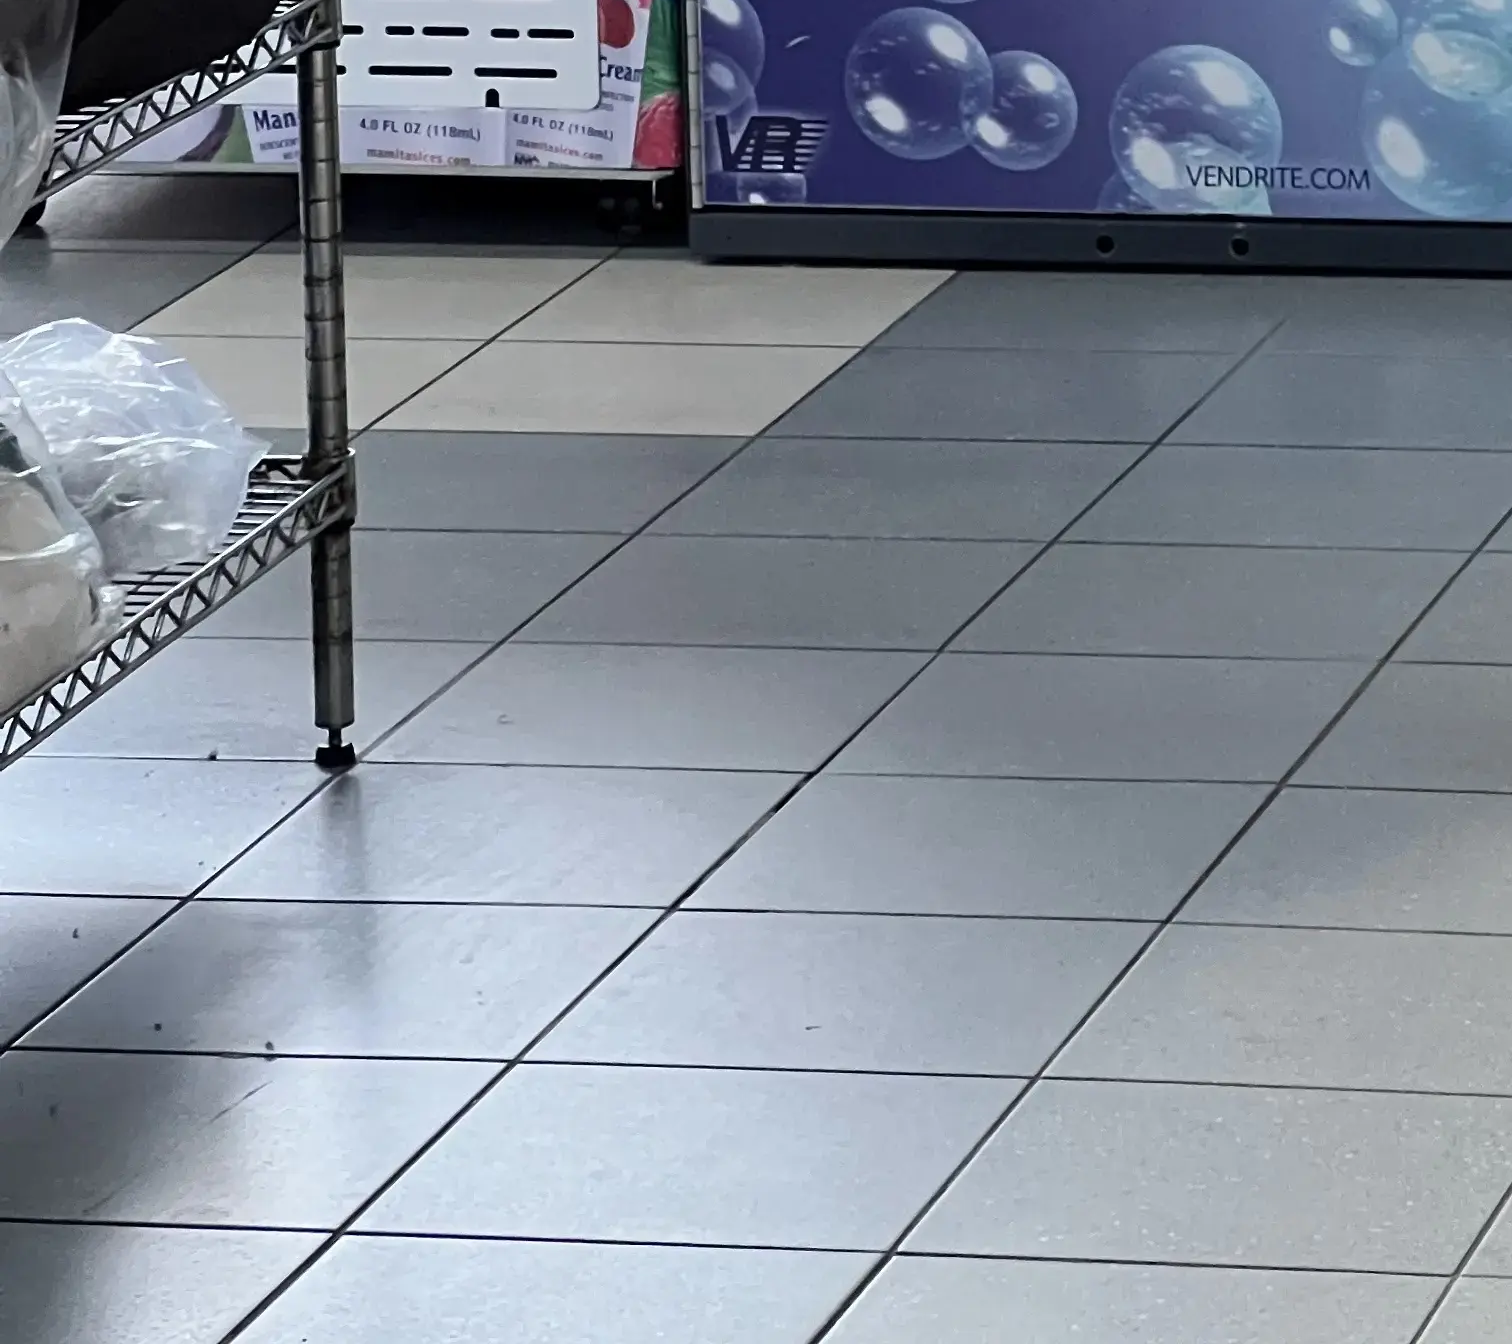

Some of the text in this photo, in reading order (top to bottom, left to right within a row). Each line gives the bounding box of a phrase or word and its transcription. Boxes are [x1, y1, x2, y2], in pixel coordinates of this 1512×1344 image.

[255, 109, 297, 132] Man
[383, 120, 397, 133] FL
[404, 121, 420, 134] OZ
[1186, 164, 1370, 191] VENDRITE.COM
